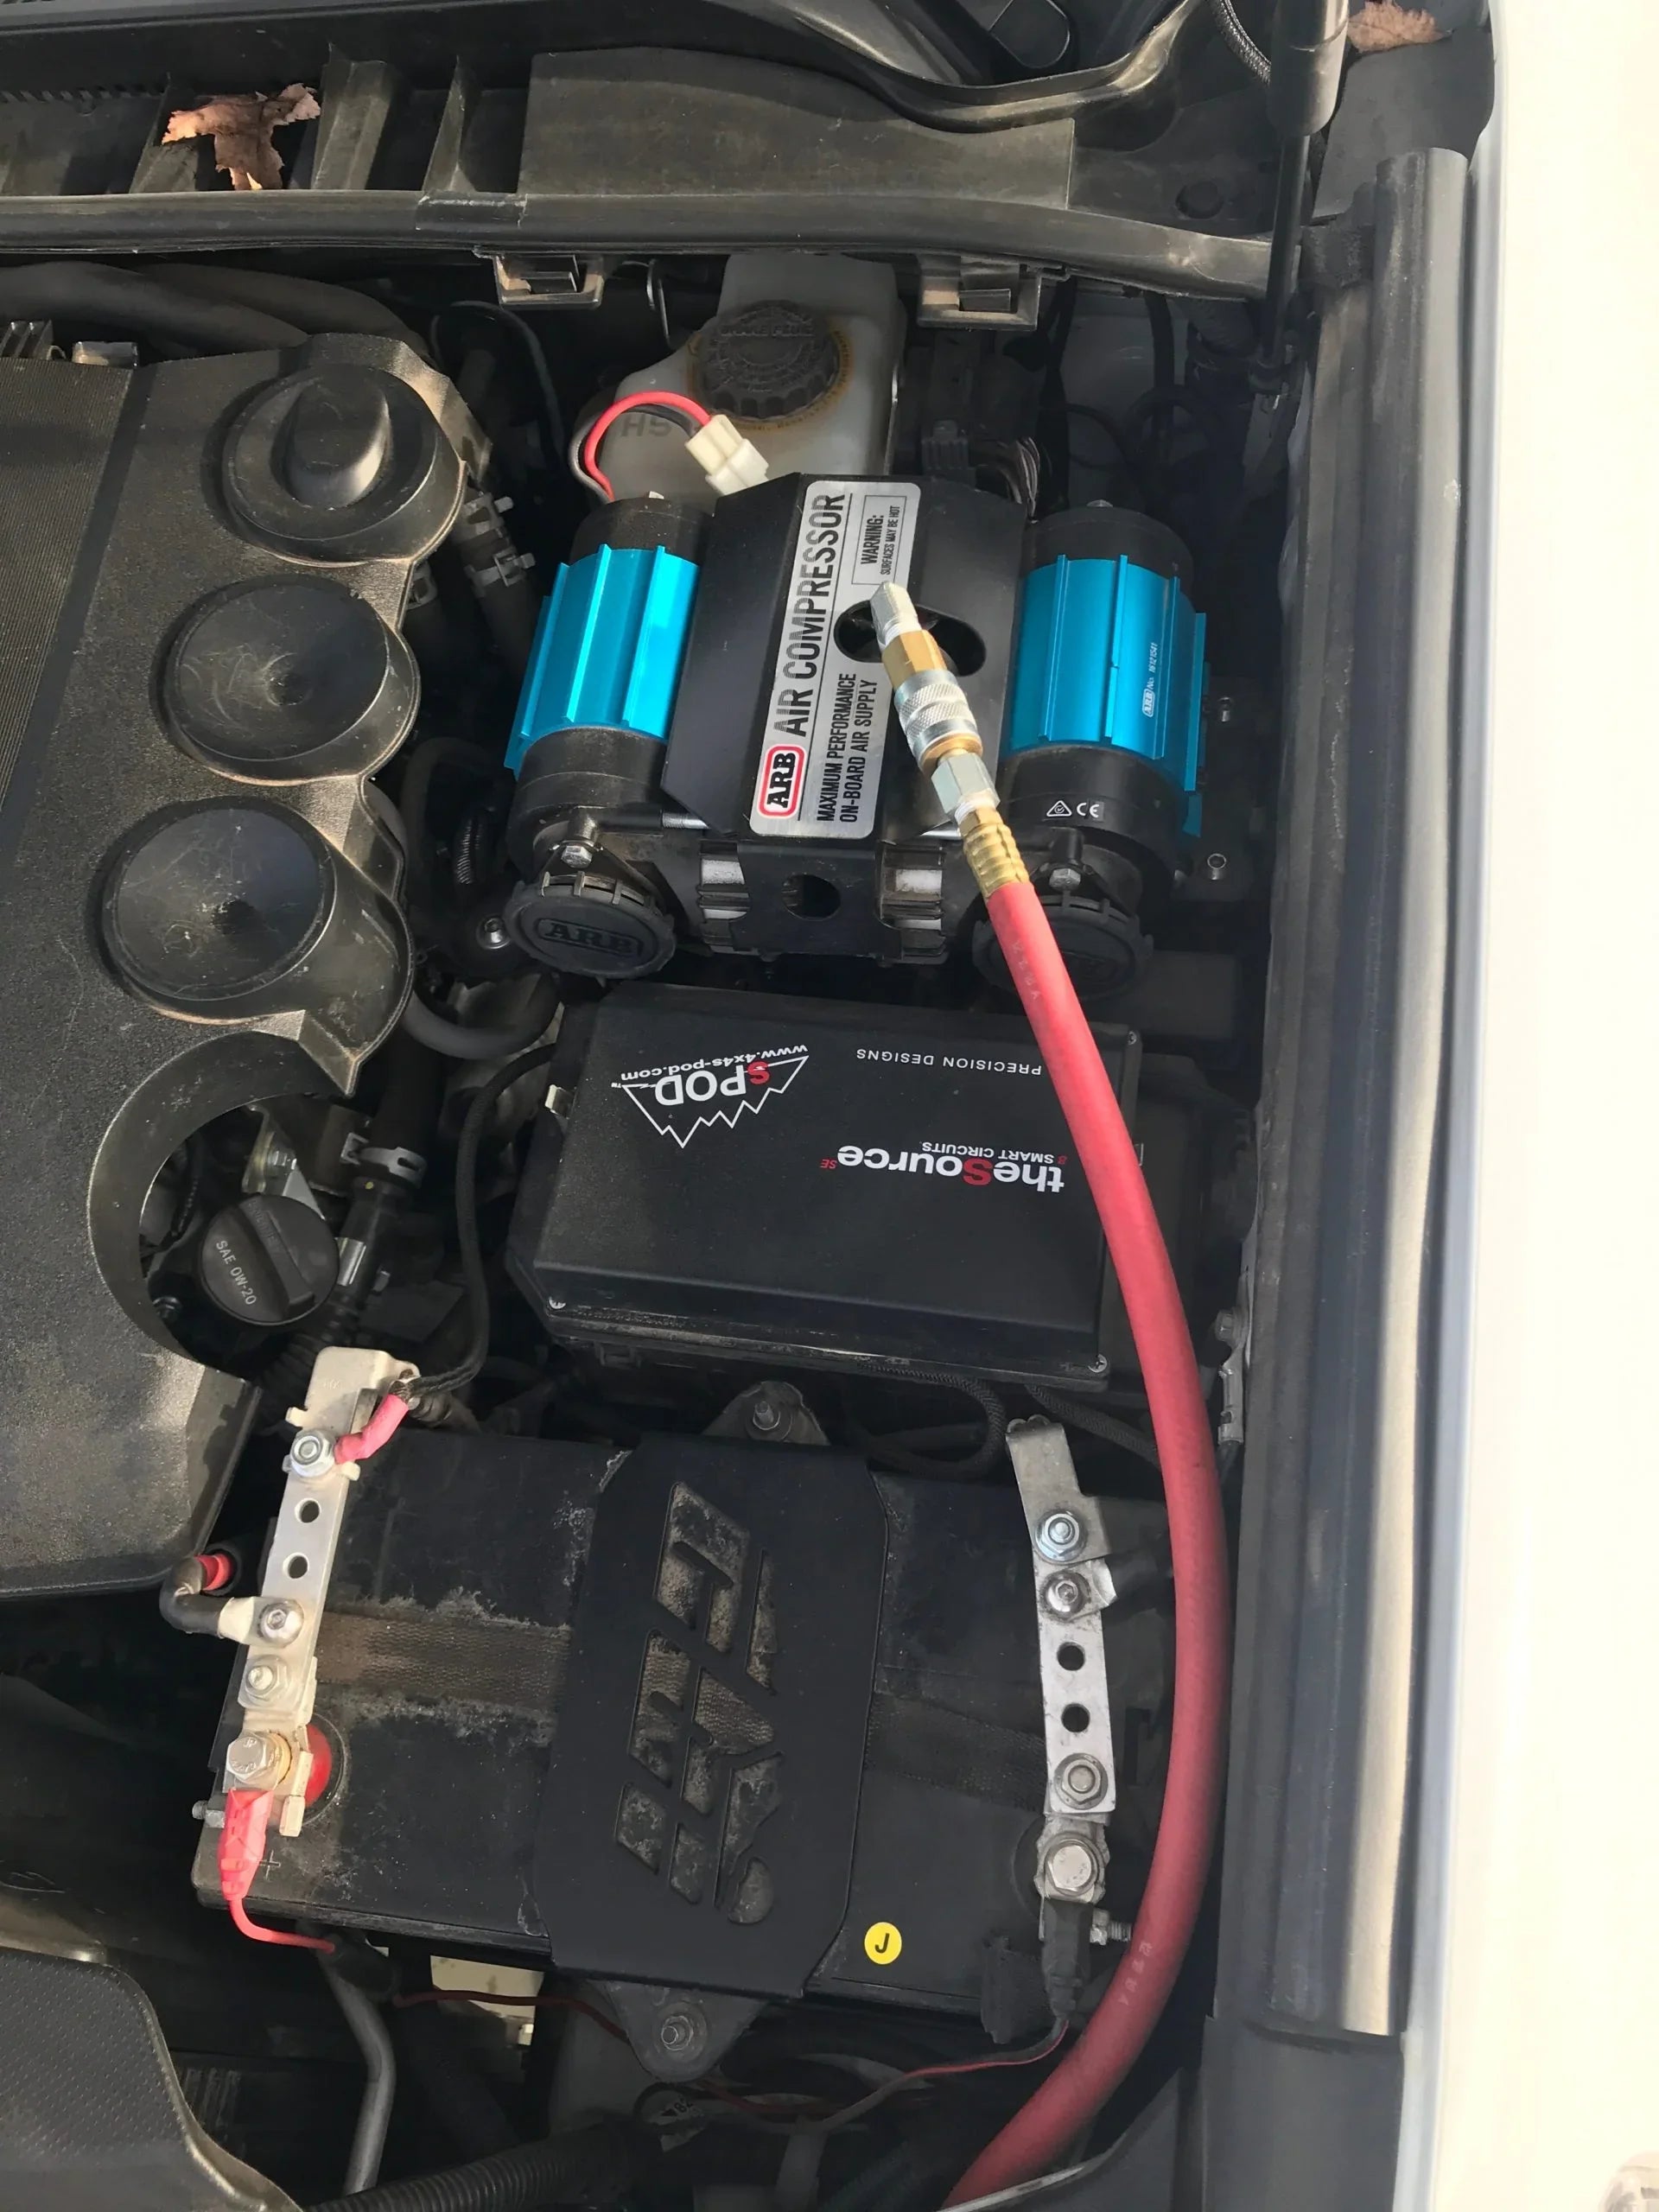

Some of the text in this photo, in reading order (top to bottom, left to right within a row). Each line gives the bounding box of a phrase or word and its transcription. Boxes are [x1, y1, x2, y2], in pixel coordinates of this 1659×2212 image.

[861, 514, 884, 564] WARNING:
[880, 505, 900, 575] SURFACES MAY BE HOT
[783, 493, 845, 679] COMPRESSOR
[773, 689, 814, 737] AIR
[817, 673, 856, 821] MAXIMUM PERFORMANCE
[840, 679, 878, 823] ON-BOARD AIR SUPPLY
[766, 753, 797, 809] ARB
[544, 922, 635, 953] ARB
[620, 1044, 809, 1081] www.4x4s-pod.com
[856, 1048, 1042, 1076] PRECISION DESIGNS
[836, 1145, 1065, 1193] theSource
[921, 1141, 995, 1159] CIRCUITS
[998, 1148, 1055, 1165] SMART
[215, 1240, 237, 1265] SAE
[874, 1933, 890, 1954] J
